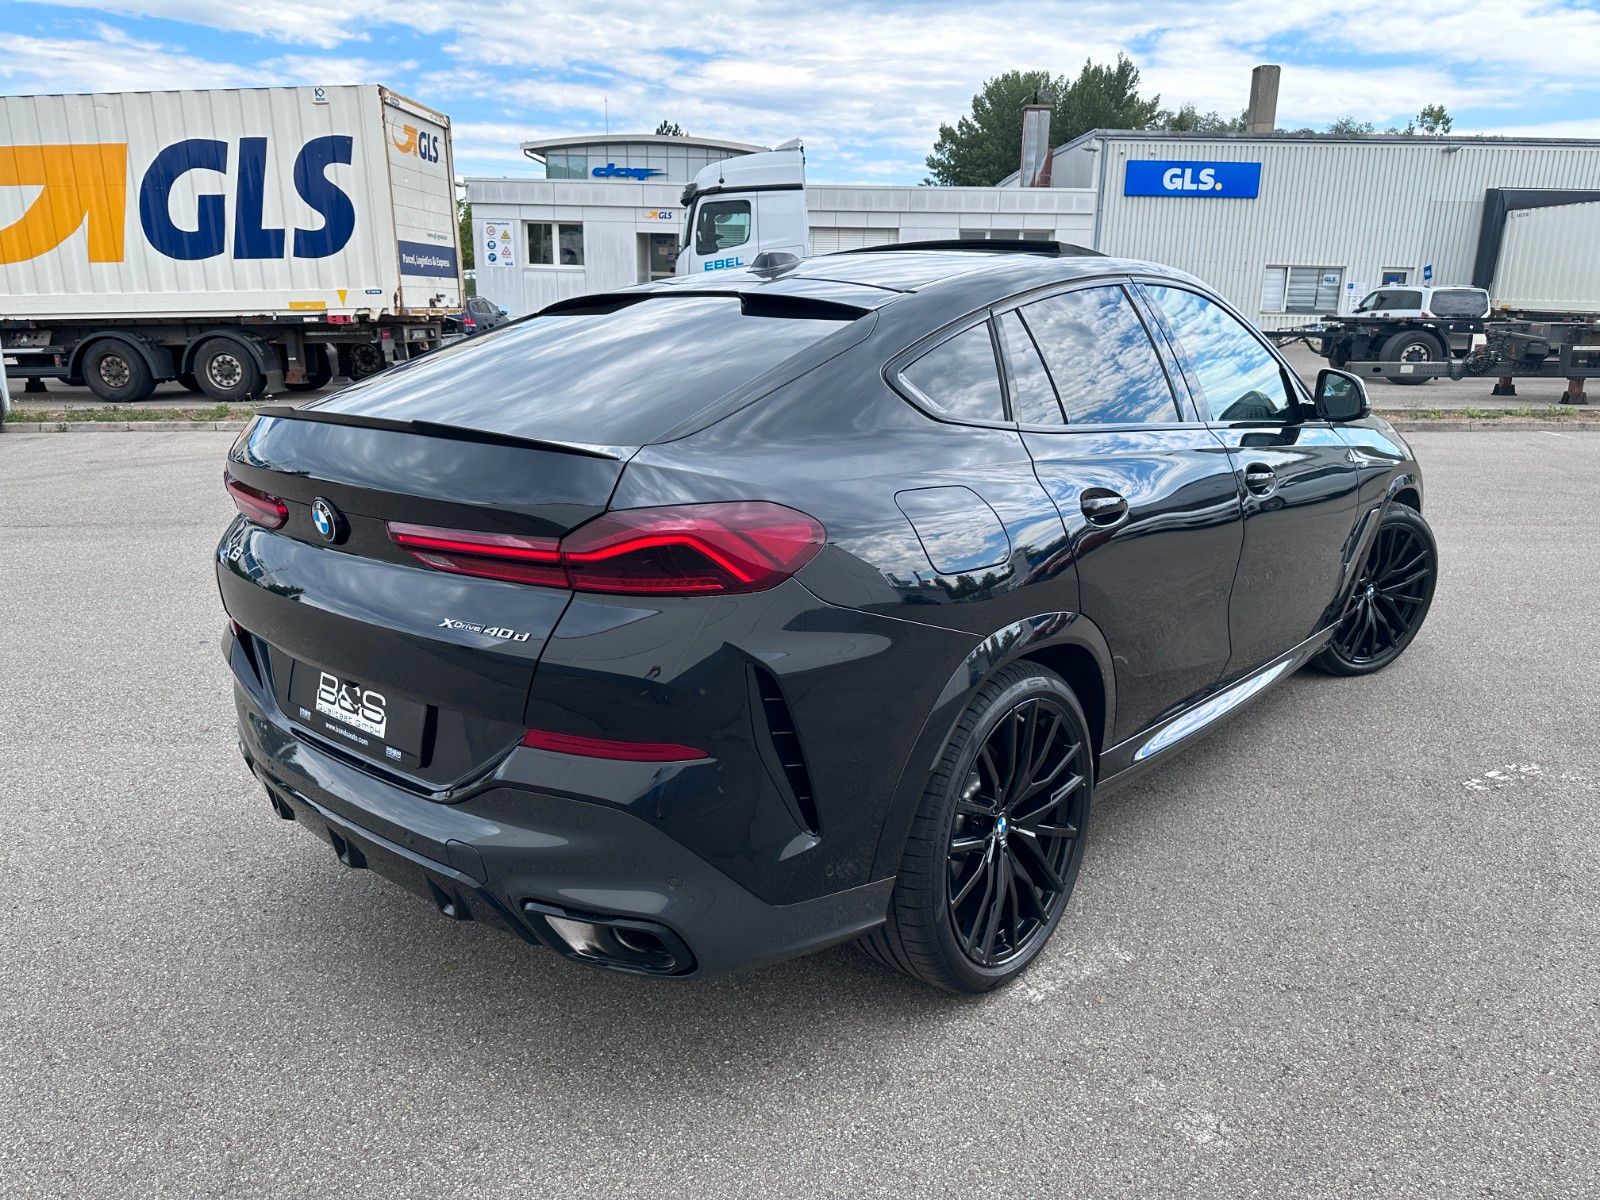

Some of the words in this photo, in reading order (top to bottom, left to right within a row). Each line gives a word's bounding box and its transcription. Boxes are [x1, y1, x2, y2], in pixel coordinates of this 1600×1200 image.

[418, 131, 439, 164] GLS
[140, 134, 356, 261] GLS
[658, 211, 673, 220] GLS
[402, 253, 416, 265] Parcel,
[416, 255, 432, 268] Logistics
[704, 256, 744, 272] EBEL
[484, 626, 532, 642] 40d
[318, 671, 387, 725] B&S
[355, 719, 382, 736] GmbH
